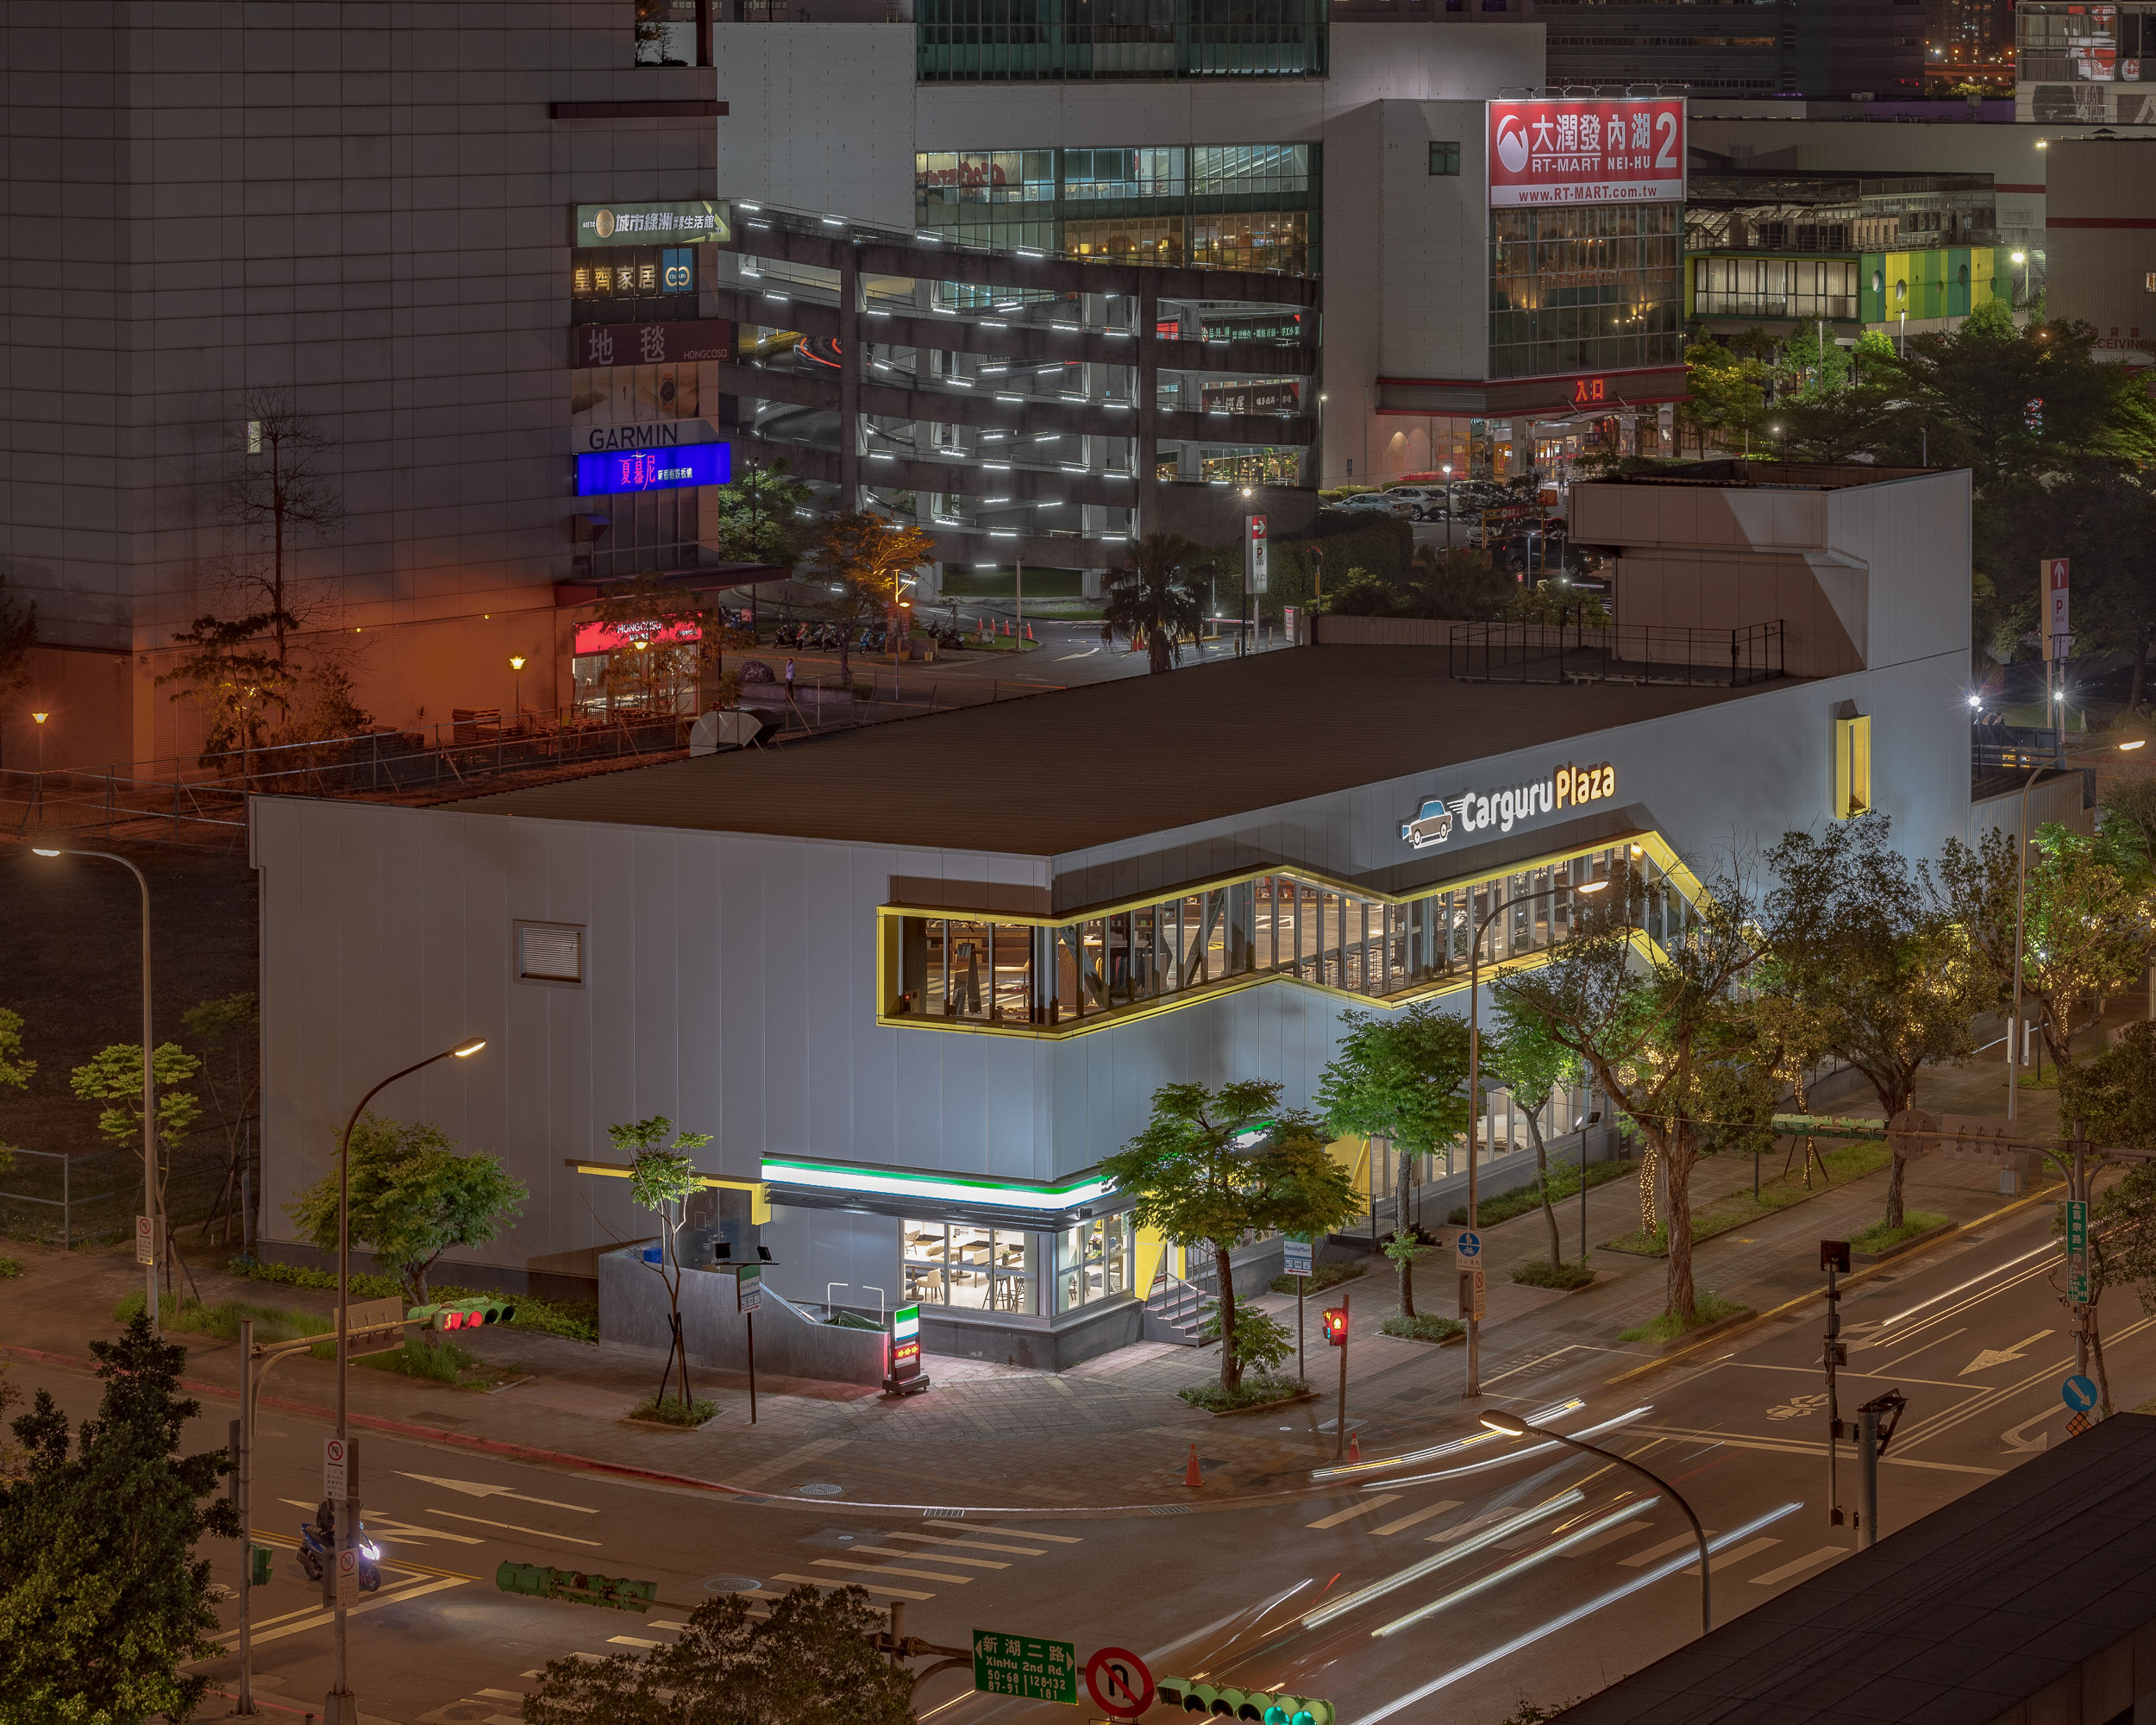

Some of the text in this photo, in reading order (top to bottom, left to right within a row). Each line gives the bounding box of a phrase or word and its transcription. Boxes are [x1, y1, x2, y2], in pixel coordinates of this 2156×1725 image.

[1532, 111, 1677, 168] 大潤發 內湖 2
[1532, 155, 1651, 172] RT-MART NEI-HU
[1519, 185, 1658, 202] www.RT-MART.com.tw
[589, 325, 665, 365] 地毯
[1576, 380, 1603, 402] 入口
[589, 423, 678, 450] GARMIN
[618, 450, 655, 490] 夏慕尼
[1257, 547, 1263, 559] P
[1256, 574, 1265, 582] 入口
[2056, 599, 2064, 614] P
[1462, 766, 1615, 832] Carguru Plaza
[1285, 1245, 1311, 1253] FamilyMart
[2068, 1268, 2084, 1276] Zong
[982, 1635, 1065, 1663] 新湖二路
[986, 1656, 1065, 1677] XinHu 2nd Rd.
[987, 1669, 1066, 1690] 50-68 128-132
[987, 1681, 1057, 1700] 87-91 181
